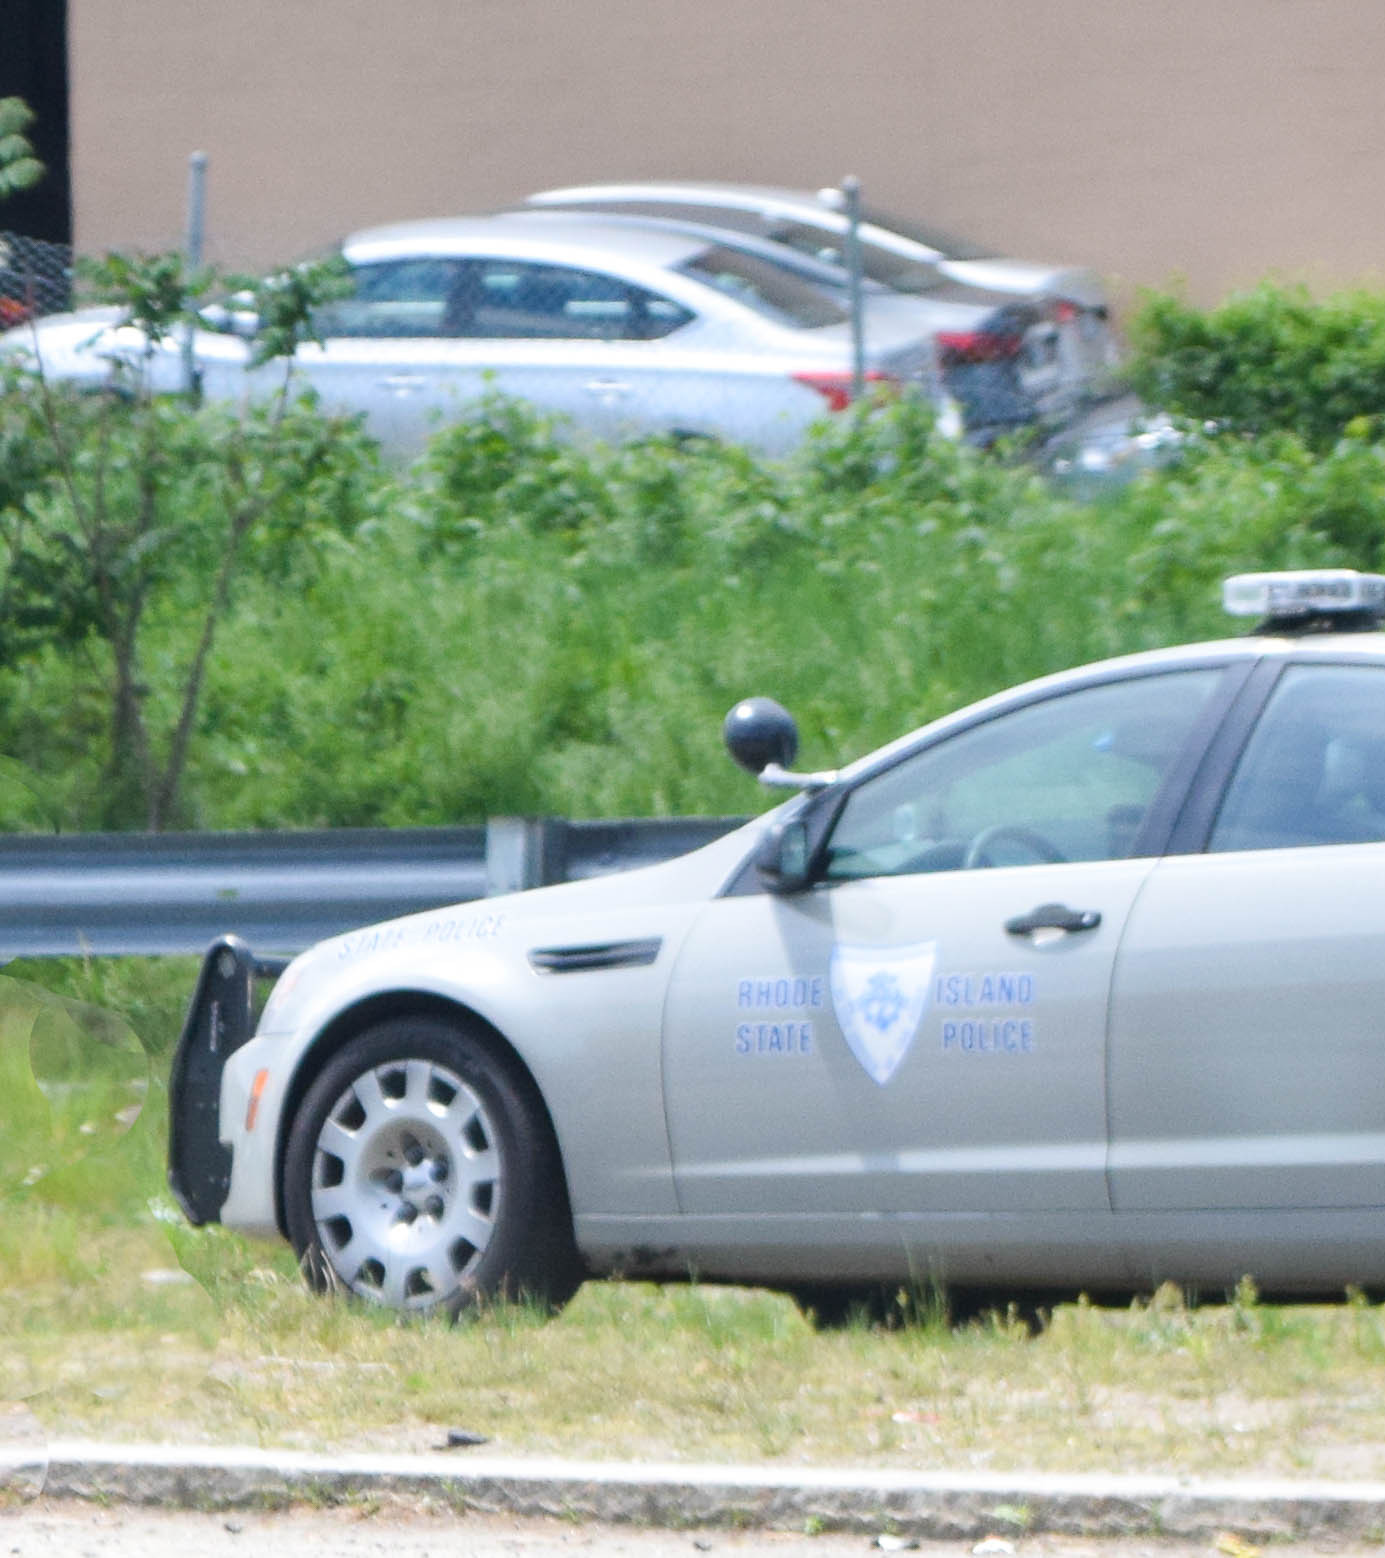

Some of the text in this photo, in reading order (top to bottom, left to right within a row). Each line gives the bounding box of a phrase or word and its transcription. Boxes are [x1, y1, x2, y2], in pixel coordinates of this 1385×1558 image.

[424, 914, 506, 944] POLICE
[738, 974, 1034, 1008] RHODE ISLAND
[736, 1020, 1033, 1052] STATE POLICE
